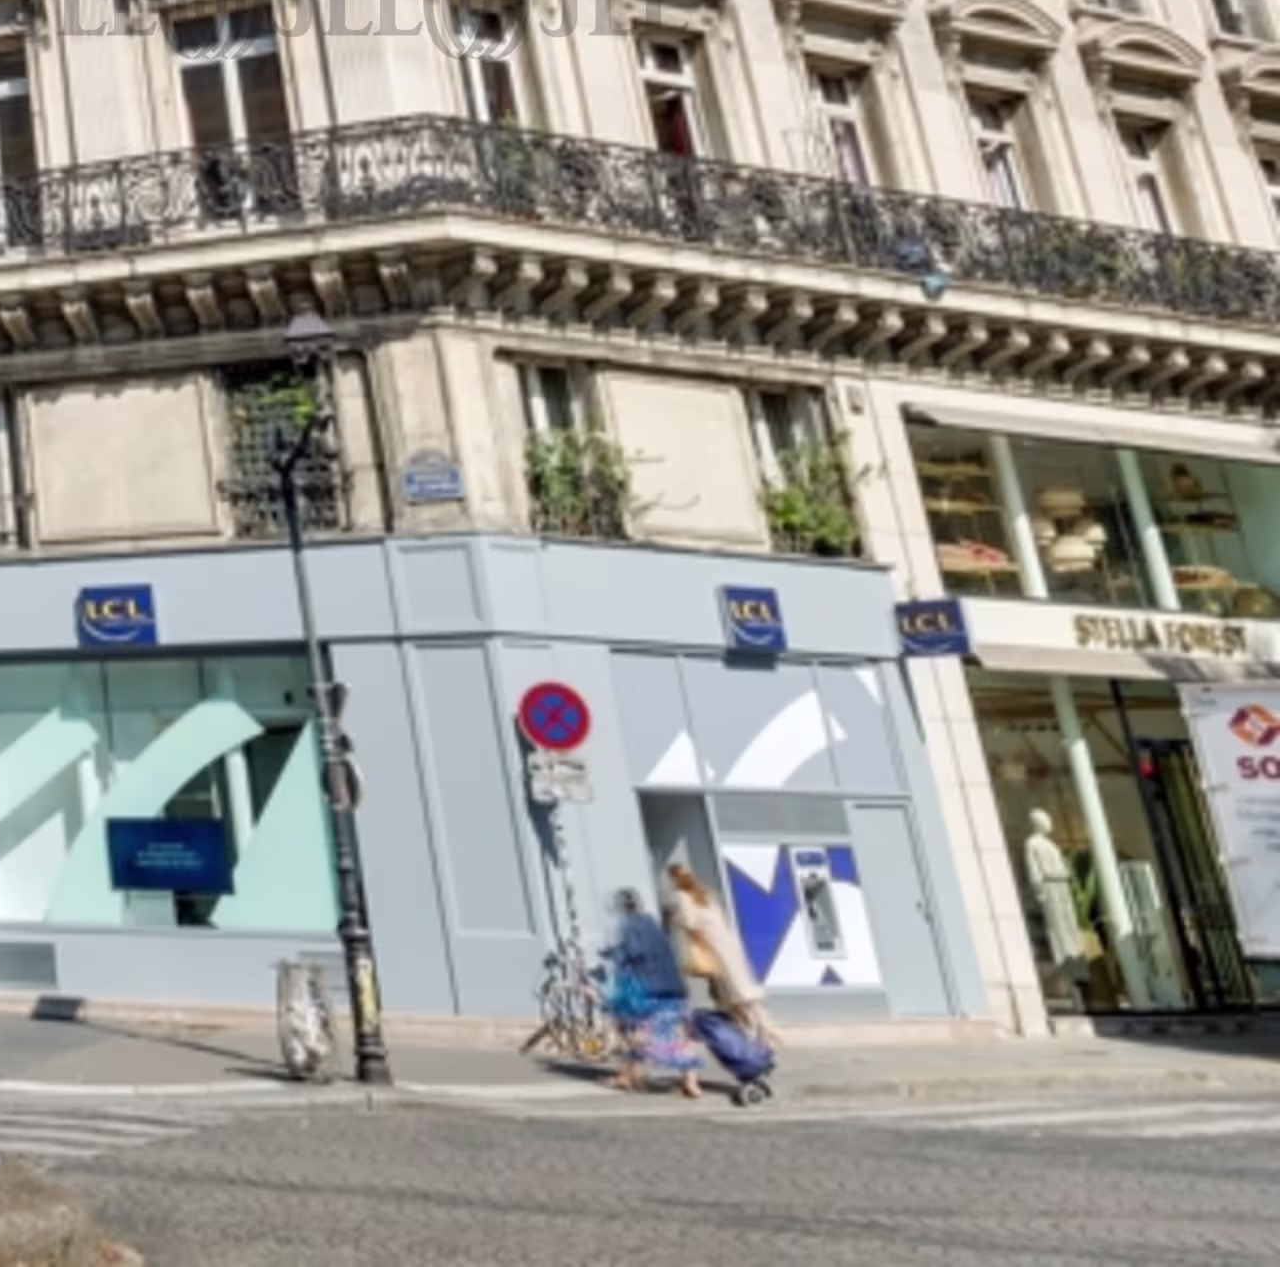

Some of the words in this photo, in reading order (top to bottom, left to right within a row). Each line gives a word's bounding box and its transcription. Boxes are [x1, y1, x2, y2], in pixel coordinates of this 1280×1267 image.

[85, 598, 144, 620] LCL
[730, 599, 773, 622] LCL
[1074, 614, 1161, 648] STELLA
[1164, 622, 1248, 656] FOREST
